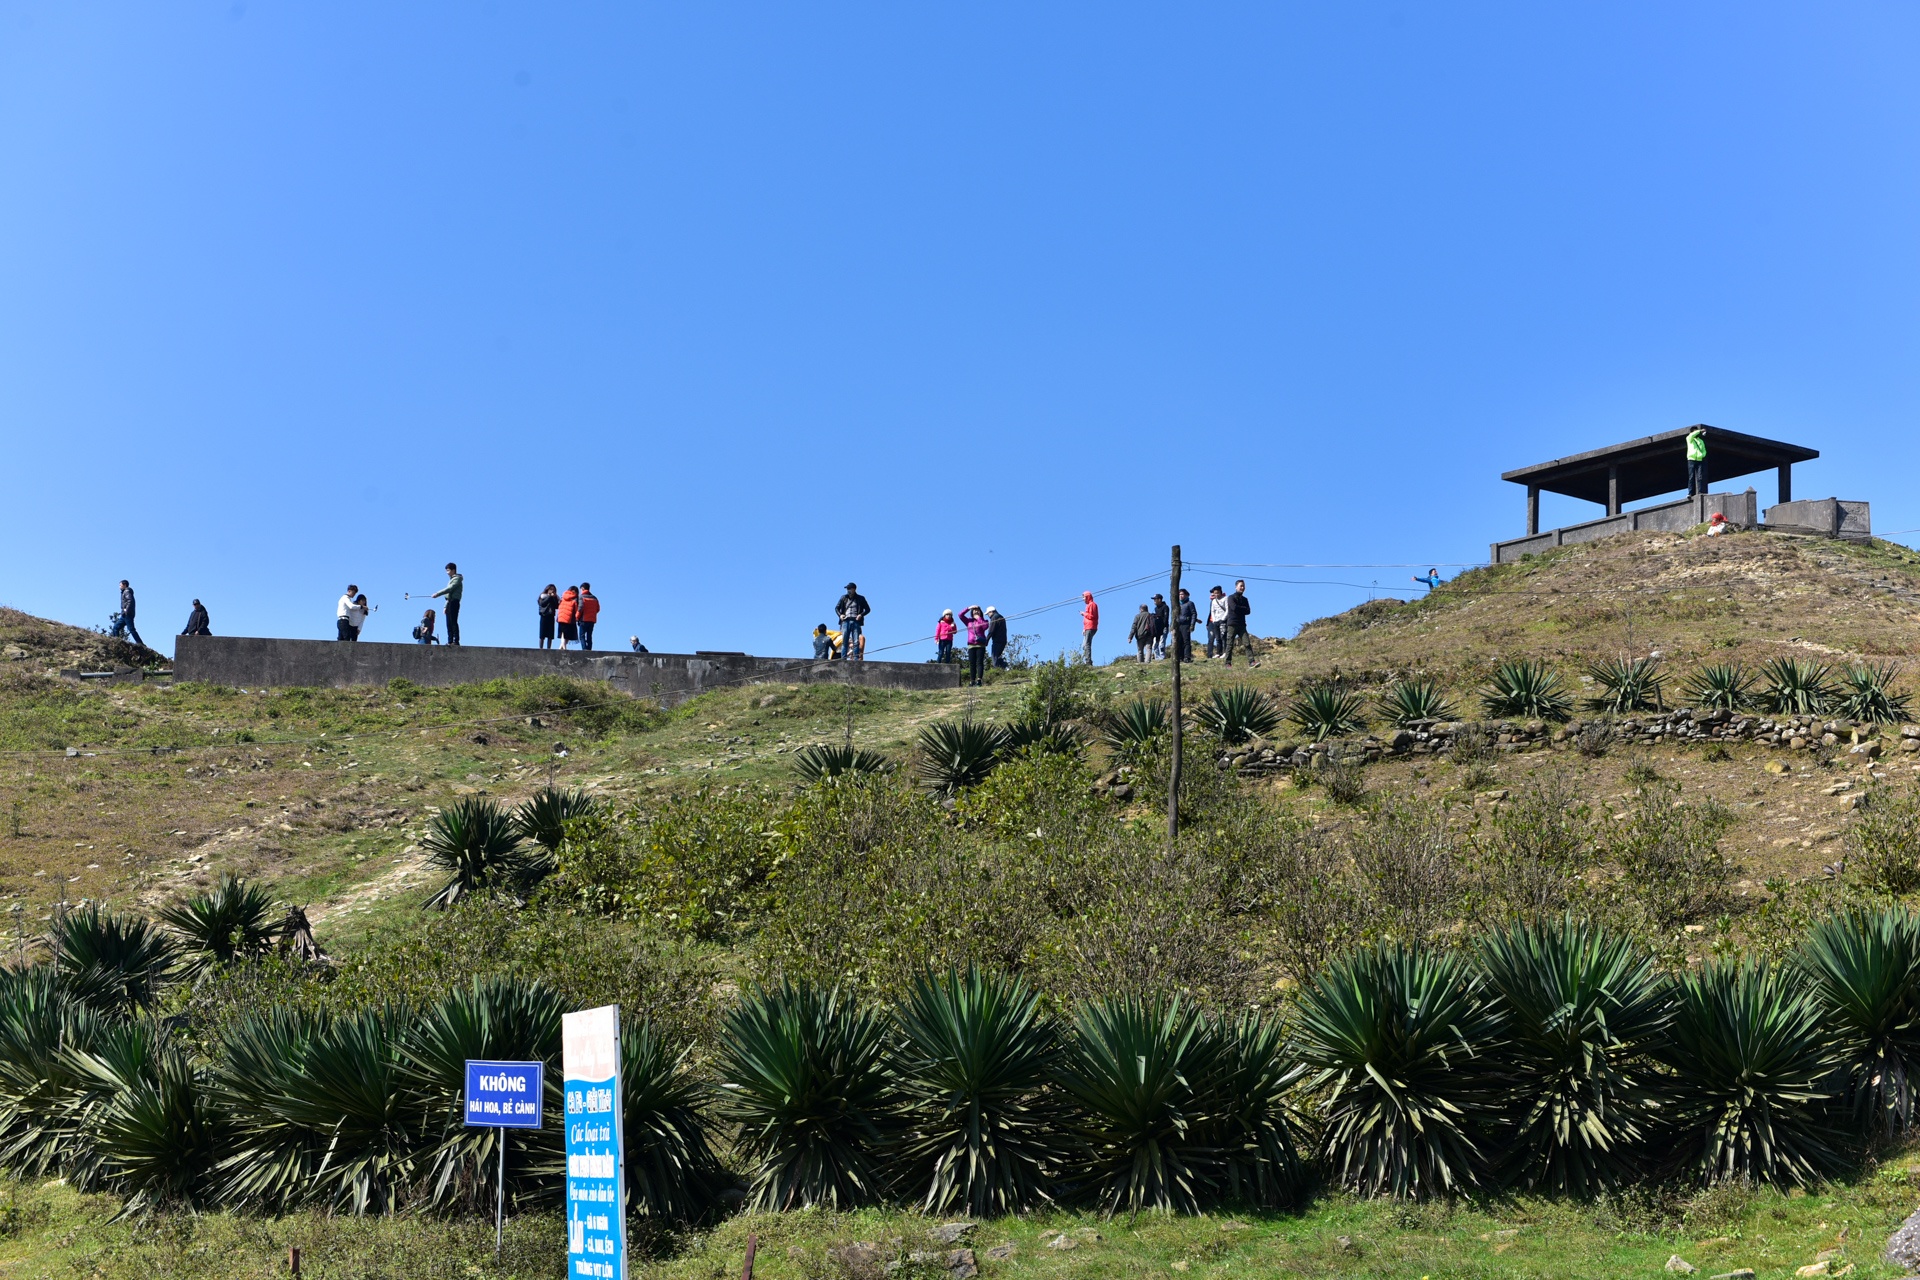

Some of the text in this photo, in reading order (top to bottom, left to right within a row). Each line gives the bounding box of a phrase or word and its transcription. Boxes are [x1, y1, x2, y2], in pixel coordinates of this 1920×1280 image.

[480, 1072, 526, 1092] KHÔNG
[470, 1098, 535, 1116] HÁI HOA, BẺ CÀNH
[572, 1121, 611, 1147] Các loại trà
